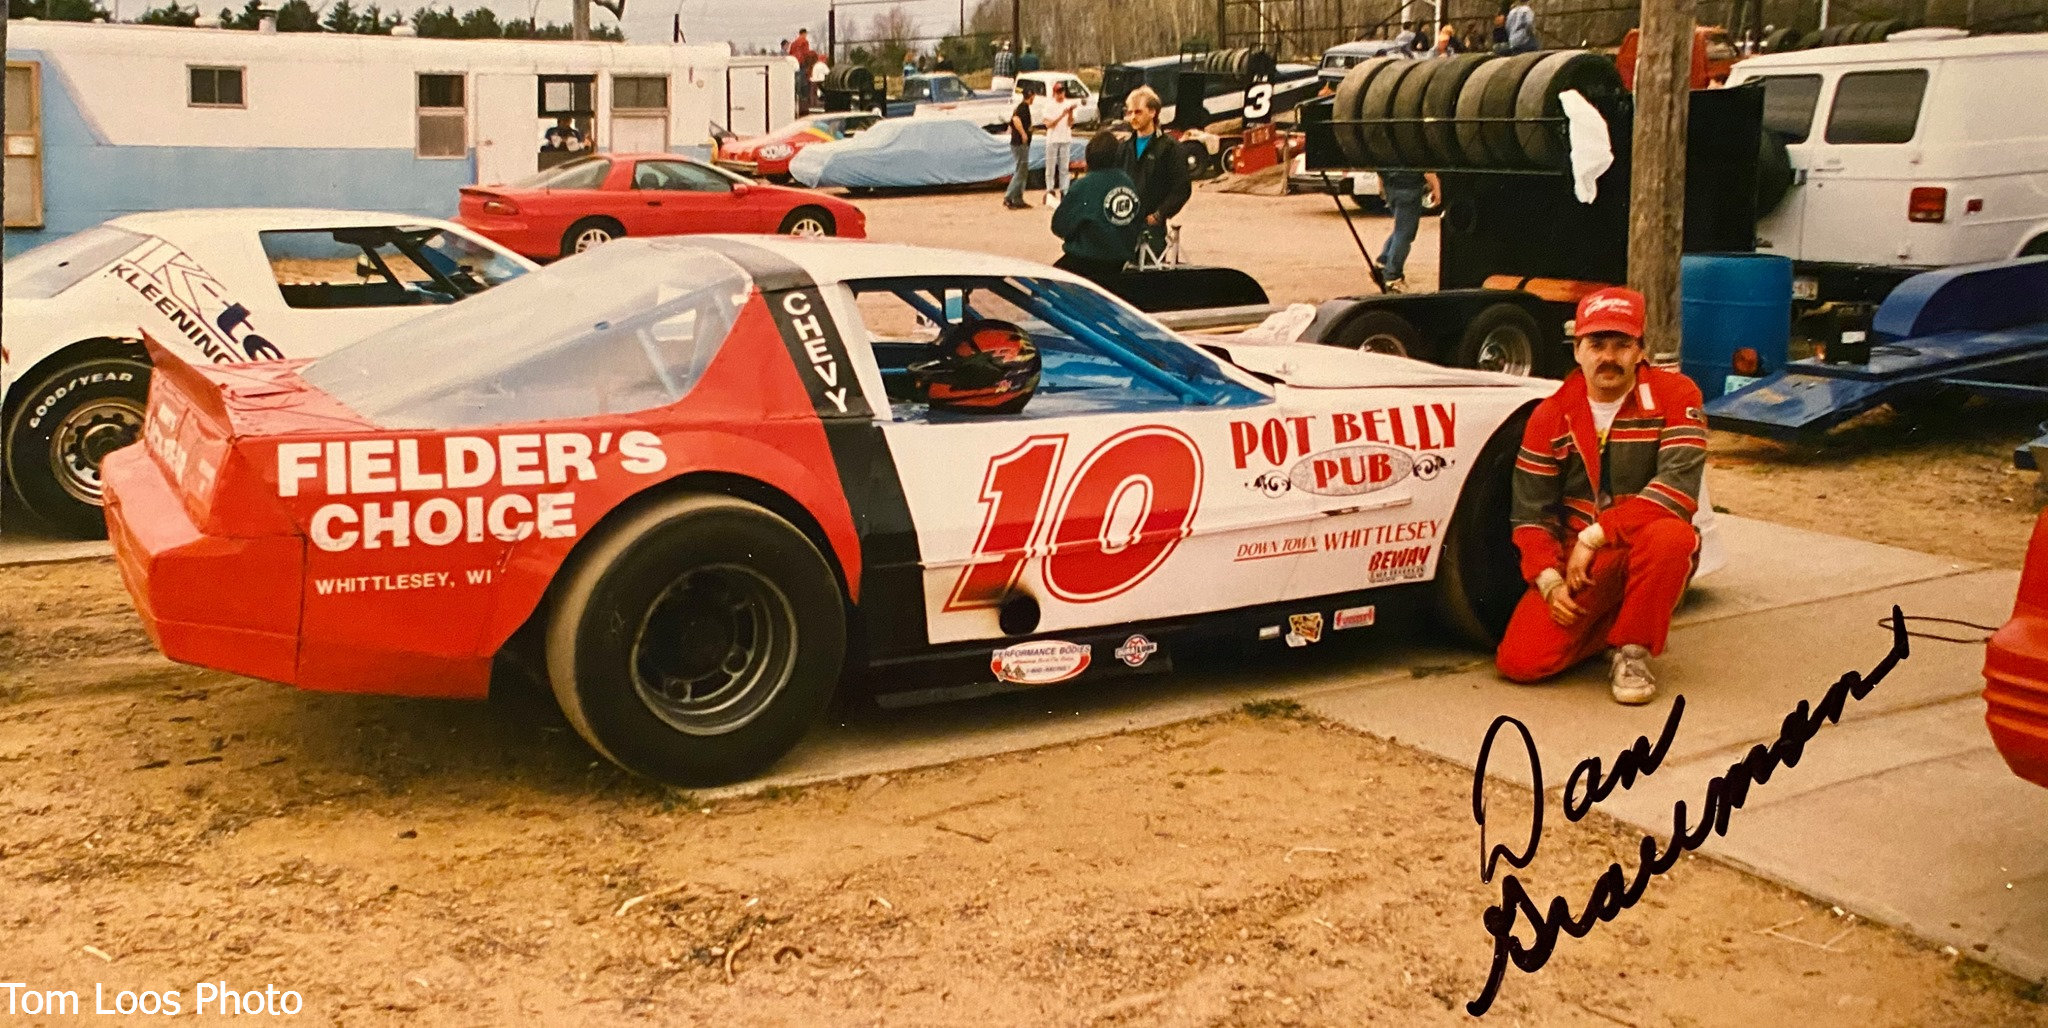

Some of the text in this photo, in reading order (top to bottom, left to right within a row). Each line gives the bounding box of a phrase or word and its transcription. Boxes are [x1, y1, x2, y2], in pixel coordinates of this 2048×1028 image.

[1243, 83, 1273, 118] 3
[782, 291, 848, 413] CHEVY
[1230, 402, 1456, 470] POT BELLY
[277, 430, 669, 497] FIELDER'S
[1312, 452, 1393, 489] PUB
[310, 492, 577, 552] CHOICE
[942, 424, 1205, 613] 10
[1236, 518, 1443, 558] DOWN TOWN WHITTLESEY
[314, 569, 493, 596] WHITTLESEY, WI
[1367, 545, 1432, 572] BEWAY
[1059, 645, 1091, 655] BODIES
[1473, 694, 1685, 883] Dan
